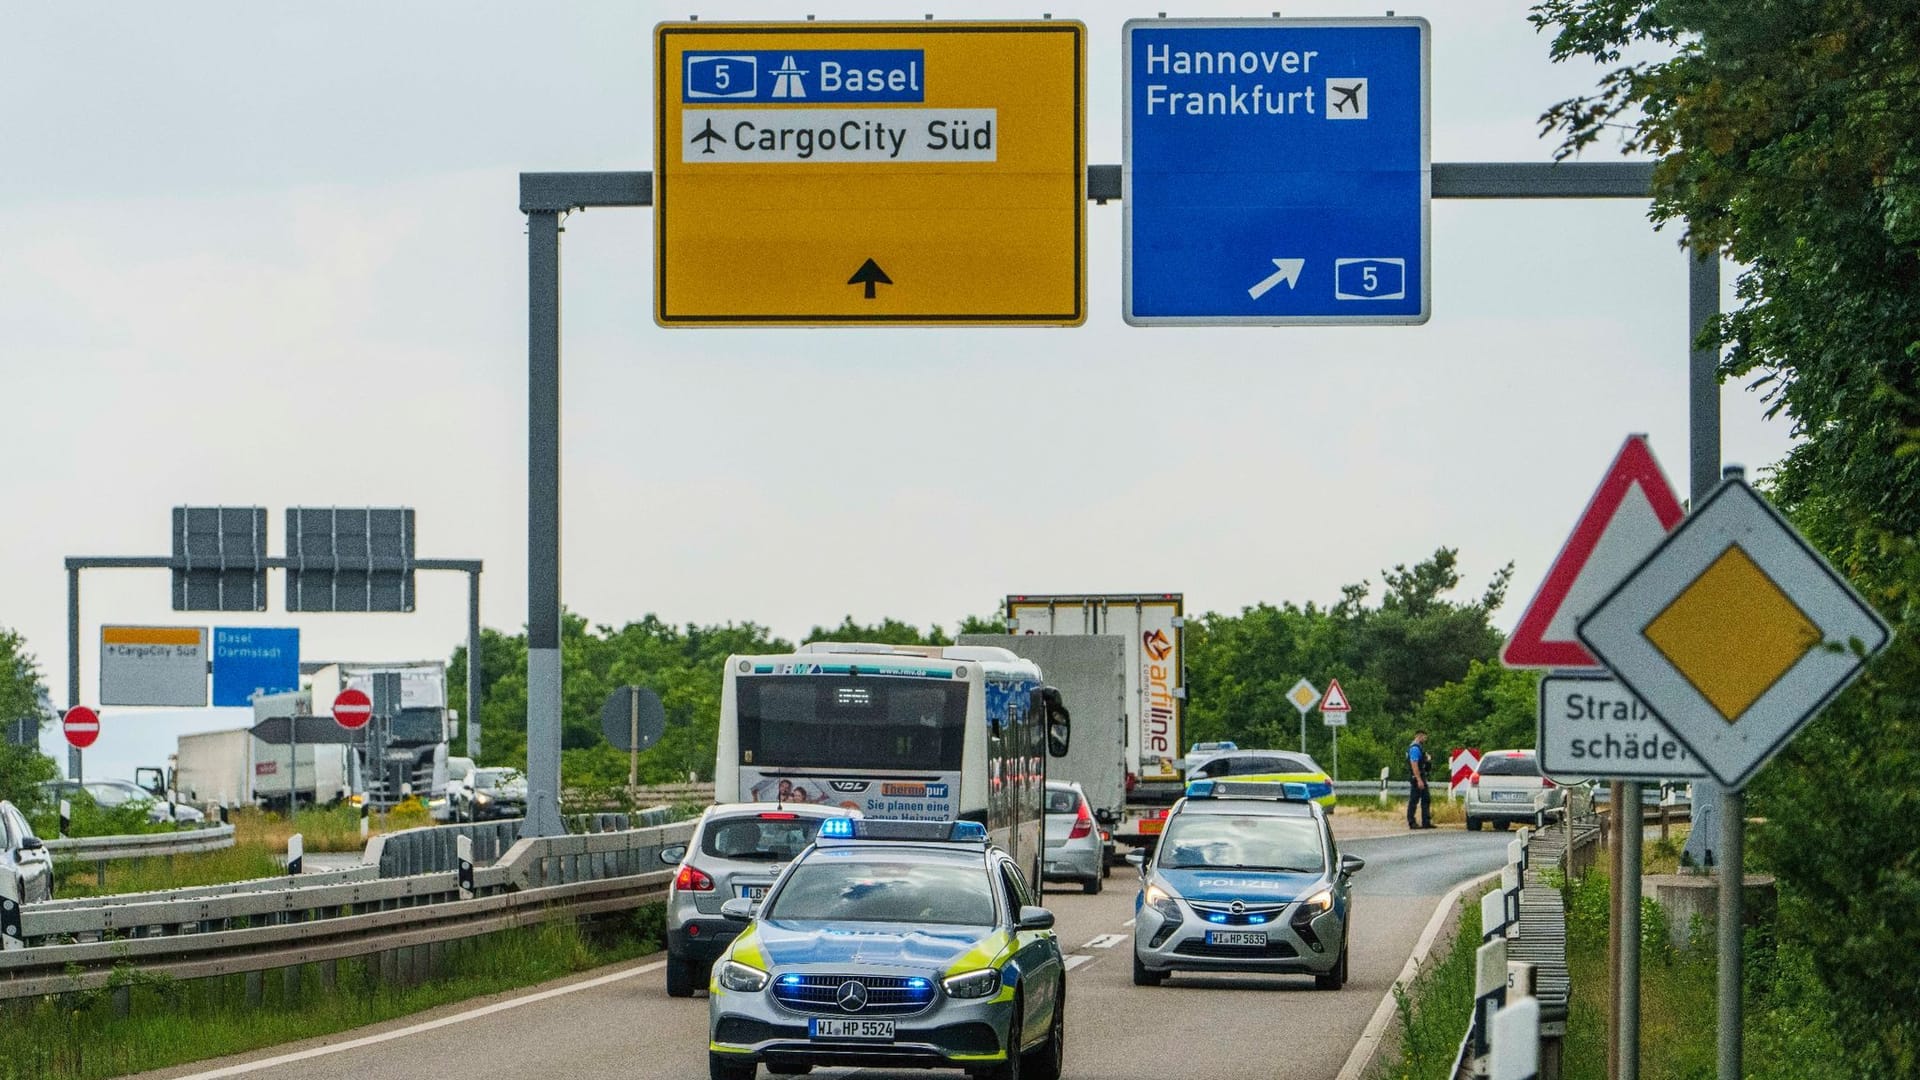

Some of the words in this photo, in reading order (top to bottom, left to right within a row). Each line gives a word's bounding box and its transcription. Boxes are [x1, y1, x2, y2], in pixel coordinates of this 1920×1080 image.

[1147, 44, 1319, 74] Hannover
[715, 64, 730, 89] 5
[820, 61, 919, 92] Basel
[1147, 84, 1316, 115] Frankfurt
[734, 120, 907, 158] CargoCity
[926, 119, 992, 150] Süd
[1362, 266, 1378, 291] 5
[218, 632, 251, 643] Basel
[118, 645, 171, 659] CargoCity
[218, 647, 281, 657] Darmstadt
[1150, 664, 1173, 752] arfiline
[834, 782, 864, 790] VDL
[867, 800, 884, 810] Sie
[888, 801, 924, 812] planen
[926, 802, 950, 811] eine
[1199, 879, 1280, 889] POLIZEI
[1230, 934, 1242, 943] HP
[818, 1021, 833, 1035] WI
[842, 1021, 859, 1035] HP
[862, 1022, 893, 1036] 5524
